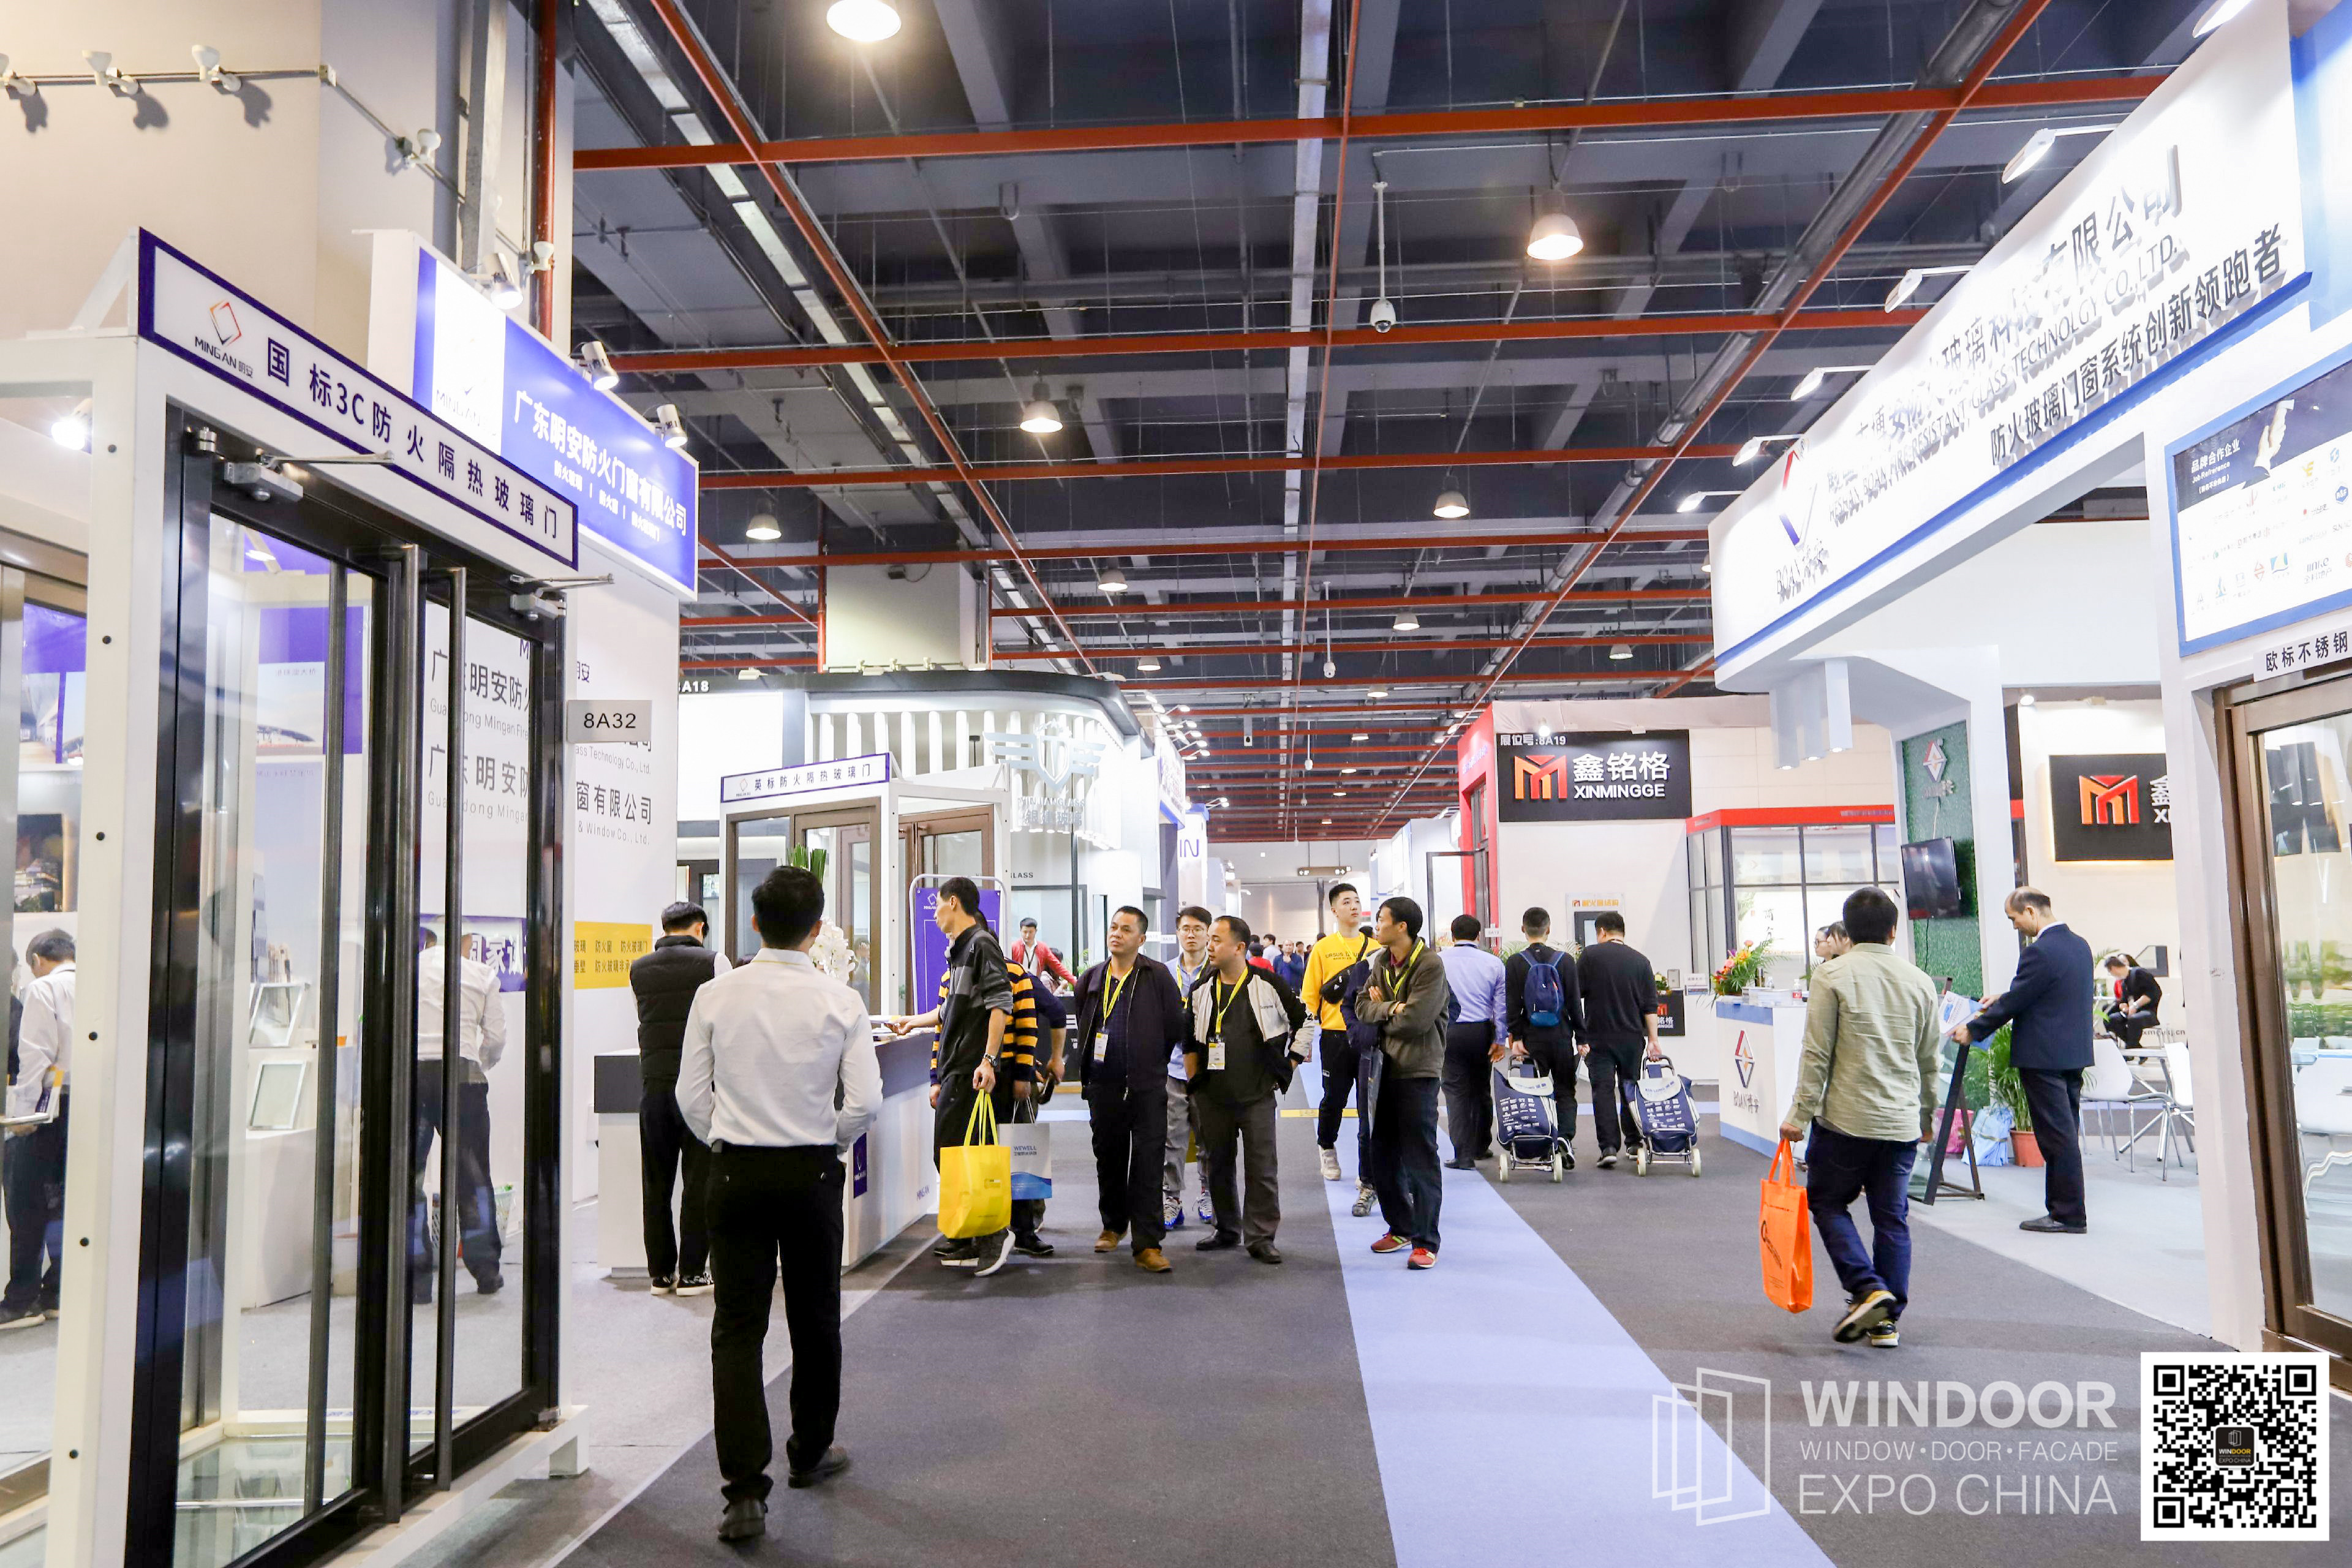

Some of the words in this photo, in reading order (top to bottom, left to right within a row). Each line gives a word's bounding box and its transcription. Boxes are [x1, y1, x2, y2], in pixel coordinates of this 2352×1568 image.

[195, 336, 237, 369] MINGAN
[1990, 222, 2281, 466] 防火玻璃门窗系统创新领跑者
[268, 337, 557, 538] 国标3C防火隔热玻璃门
[2192, 439, 2241, 473] 品牌合作企业
[2266, 631, 2348, 671] 欧标不锈钢
[677, 680, 710, 693] A18
[485, 714, 515, 736] Mingan
[584, 713, 636, 728] 8A32
[755, 763, 870, 791] 英标防火隔热玻璃门
[1573, 751, 1670, 782] 鑫铭格
[1574, 783, 1666, 799] XINMINGGE
